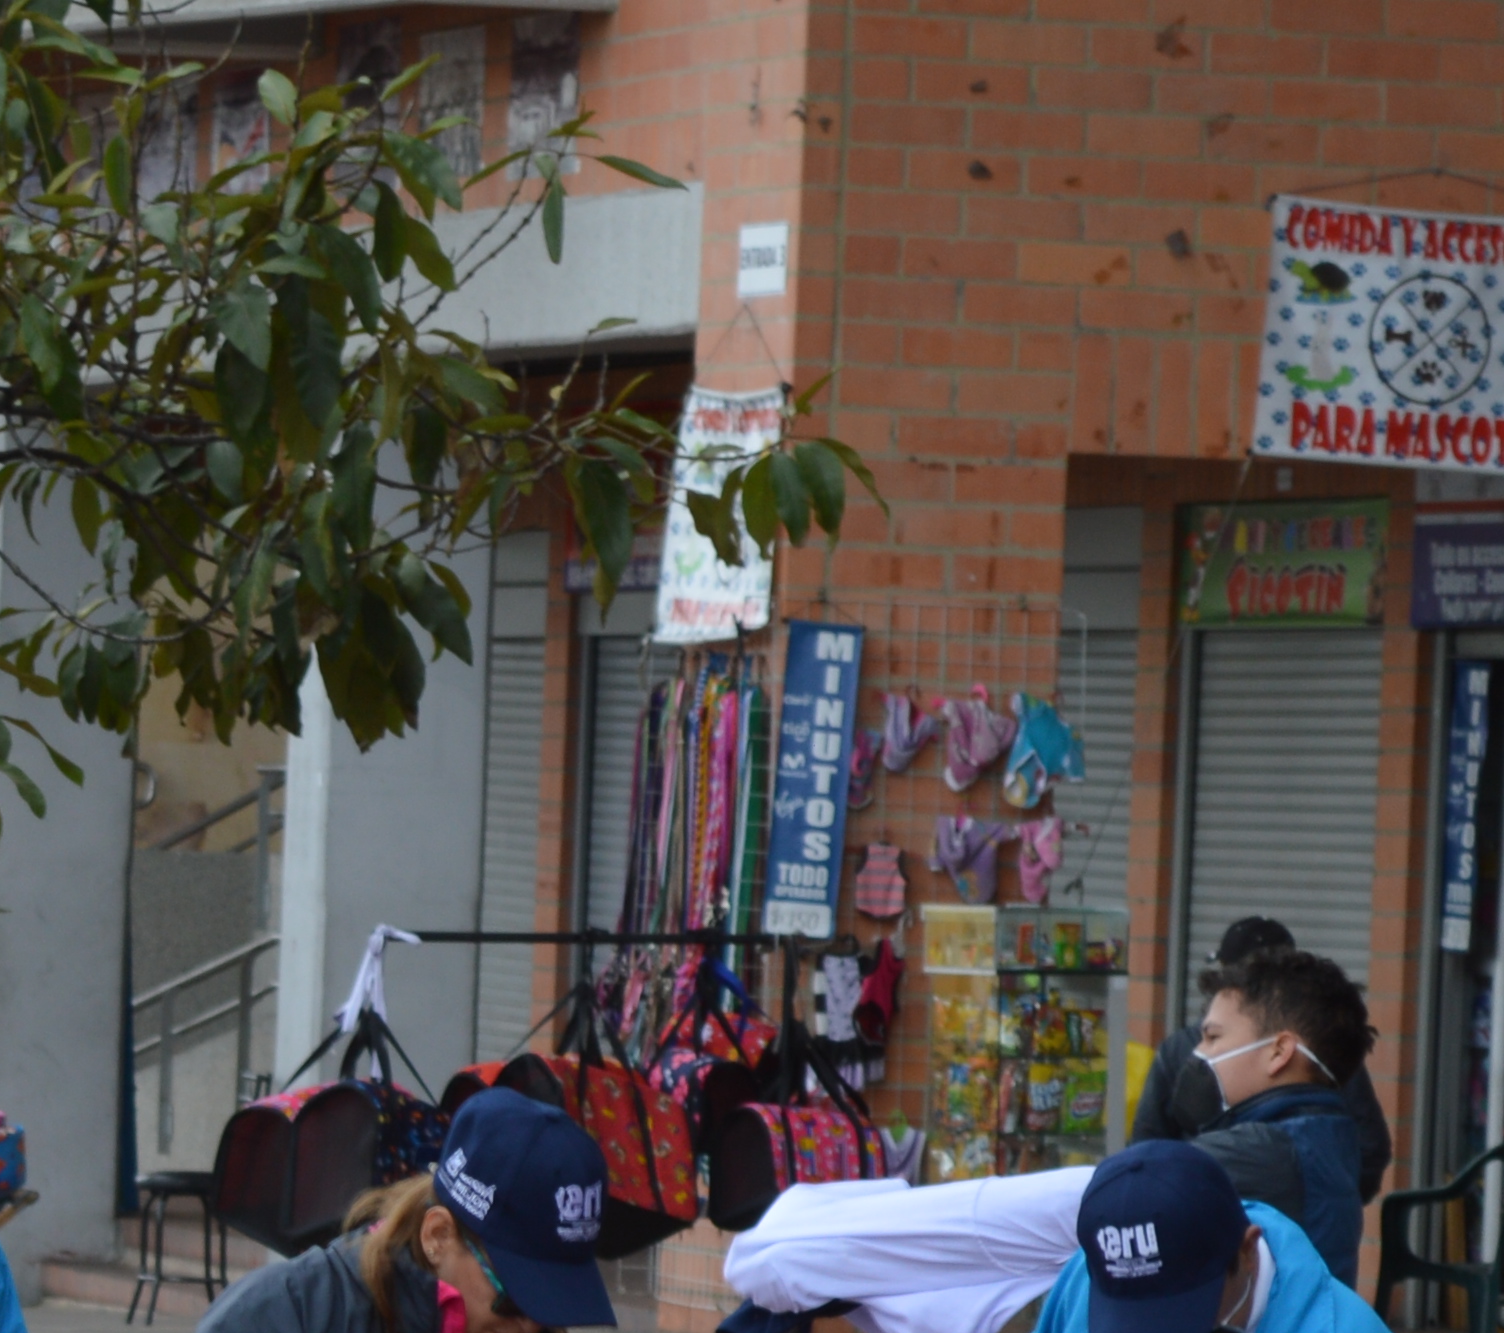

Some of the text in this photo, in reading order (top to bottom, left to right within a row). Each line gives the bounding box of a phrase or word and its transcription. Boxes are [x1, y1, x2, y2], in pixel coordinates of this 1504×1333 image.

[1286, 205, 1394, 256] COMIDA
[1400, 216, 1418, 258] Y
[1289, 400, 1377, 456] PARA
[802, 630, 855, 862] MINUTOS
[1458, 669, 1489, 880] MINUTOS
[777, 862, 829, 888] TODO
